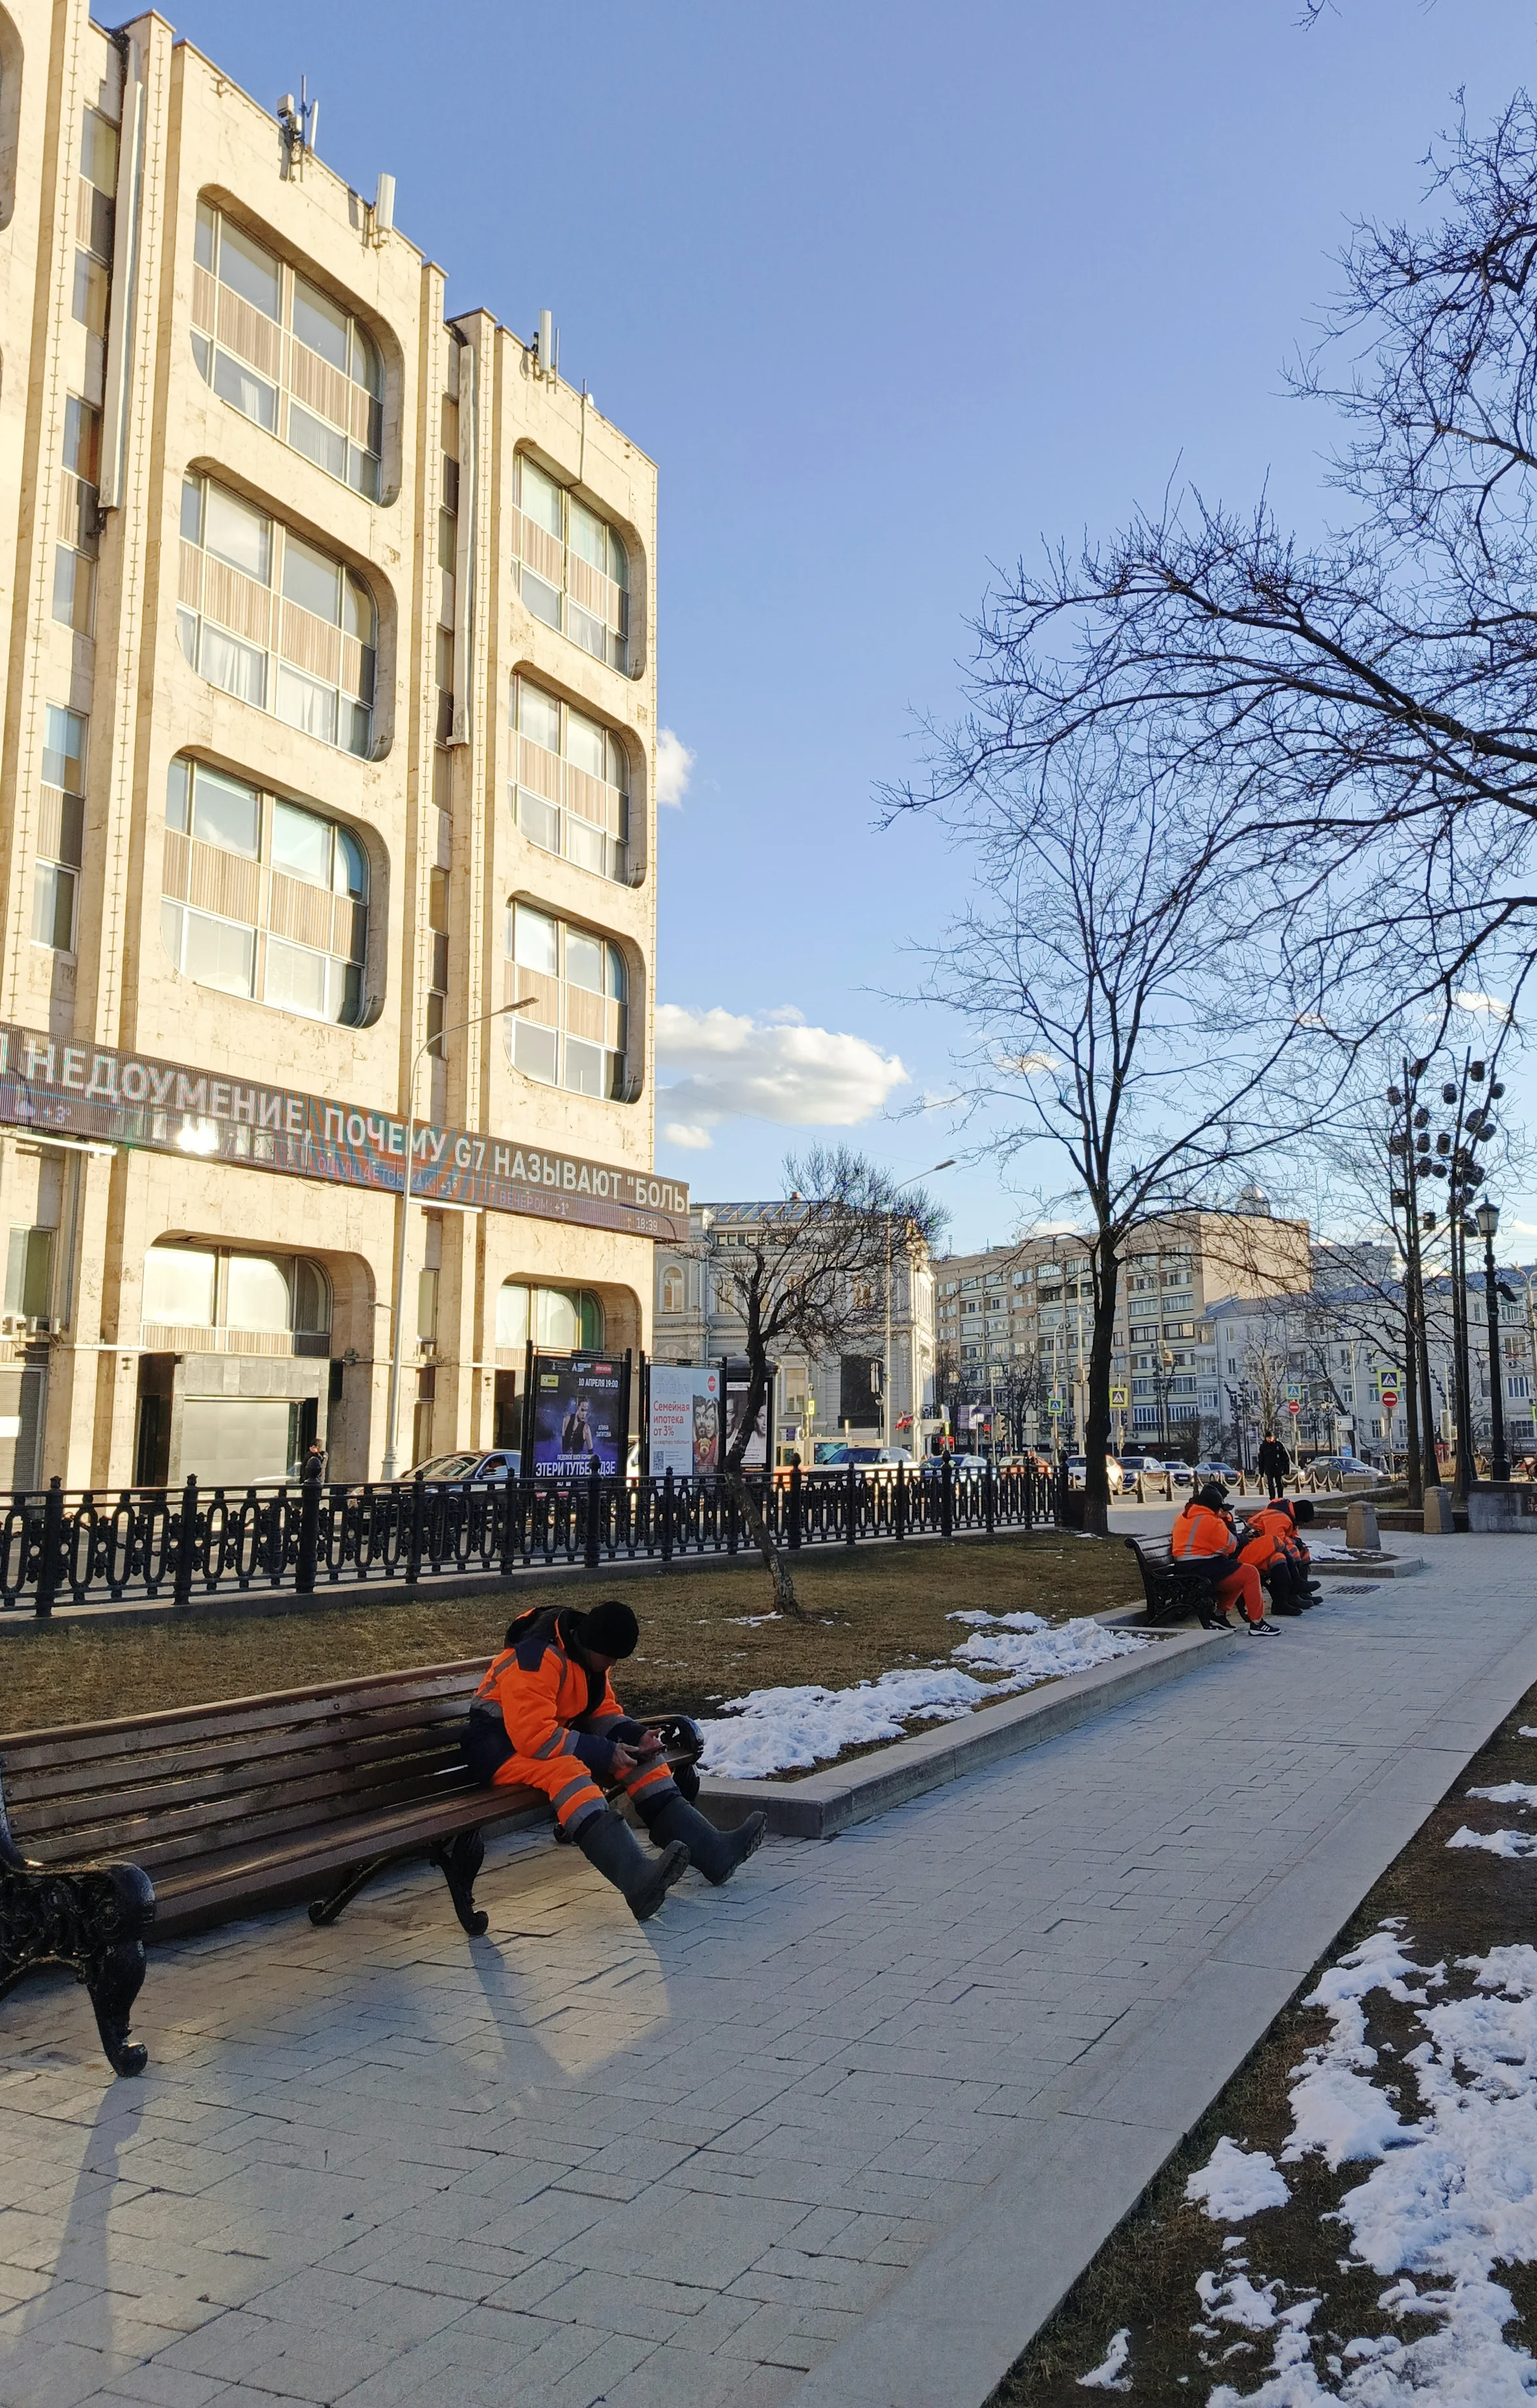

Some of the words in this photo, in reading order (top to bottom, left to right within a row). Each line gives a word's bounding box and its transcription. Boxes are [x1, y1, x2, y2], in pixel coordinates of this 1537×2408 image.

[27, 1039, 311, 1142] НЕДОУМЕНИЕ,
[325, 1107, 446, 1161] ПОЧЕМУ
[455, 1138, 485, 1171] G7
[495, 1145, 621, 1200] НАЗЫВАЮТ
[636, 1217, 658, 1232] 18:39
[578, 1377, 585, 1387] 10
[585, 1378, 605, 1388] АПРЕЛЯ
[606, 1379, 619, 1388] 19:00
[653, 1400, 691, 1412] Семейная
[653, 1416, 685, 1424] ипотека
[653, 1427, 662, 1436] от
[663, 1425, 675, 1436] 3%
[535, 1461, 563, 1477] ЭТЕРИ
[565, 1461, 616, 1476] ТУТБЕДЗЕ
